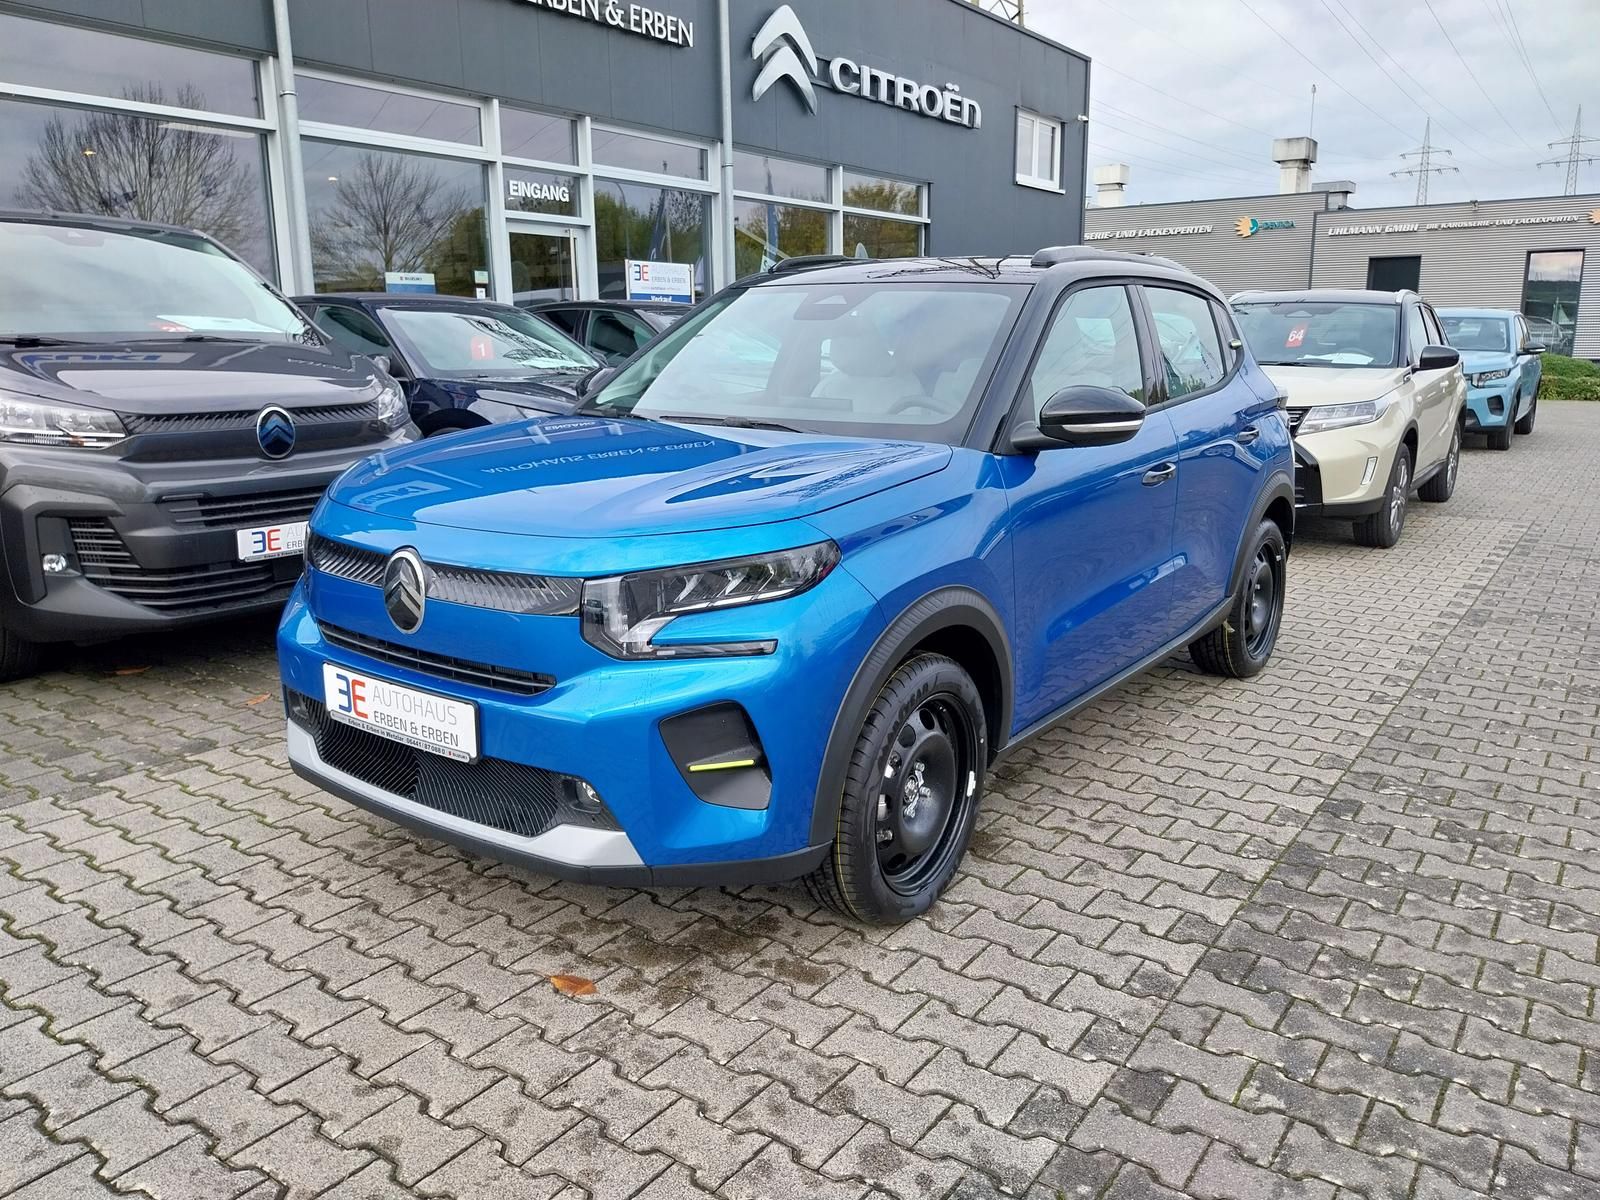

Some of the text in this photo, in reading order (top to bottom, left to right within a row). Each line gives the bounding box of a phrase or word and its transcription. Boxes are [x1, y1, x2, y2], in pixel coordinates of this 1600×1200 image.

[605, 0, 624, 28] &
[630, 3, 694, 47] ERBEN
[508, 179, 570, 203] EINGANG
[1115, 229, 1136, 239] UND
[1138, 224, 1213, 238] LACKEXPERTEN
[1327, 225, 1382, 237] UHLMANN
[1496, 217, 1513, 226] UND
[1288, 328, 1304, 342] 64
[478, 343, 485, 357] 1
[372, 685, 457, 726] AUTOHAUS
[373, 710, 459, 747] ERBEN & ERBEN
